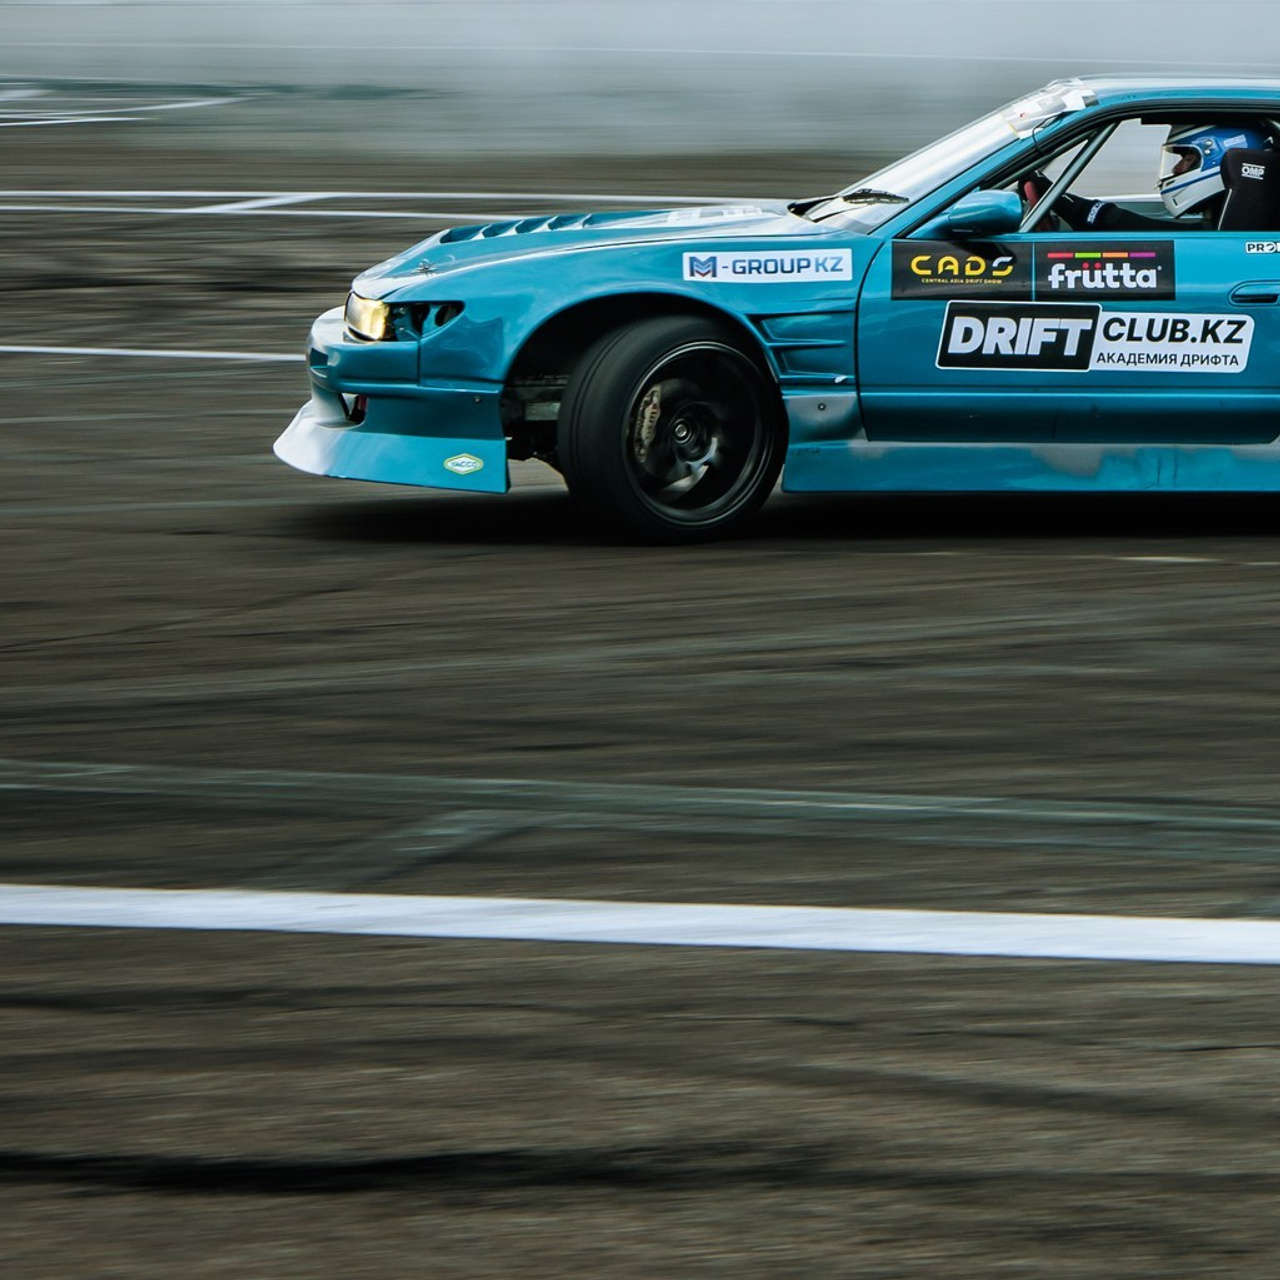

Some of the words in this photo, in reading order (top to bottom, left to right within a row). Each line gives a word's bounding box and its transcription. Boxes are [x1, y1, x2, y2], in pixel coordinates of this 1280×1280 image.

[1241, 166, 1265, 177] OMP
[815, 256, 844, 273] KZ
[910, 255, 1014, 276] CADS
[1047, 262, 1157, 289] frütta
[1102, 317, 1247, 344] CLUB.KZ
[1096, 352, 1178, 366] АКАДЕМИЯ
[1180, 353, 1239, 367] ДРИФТА
